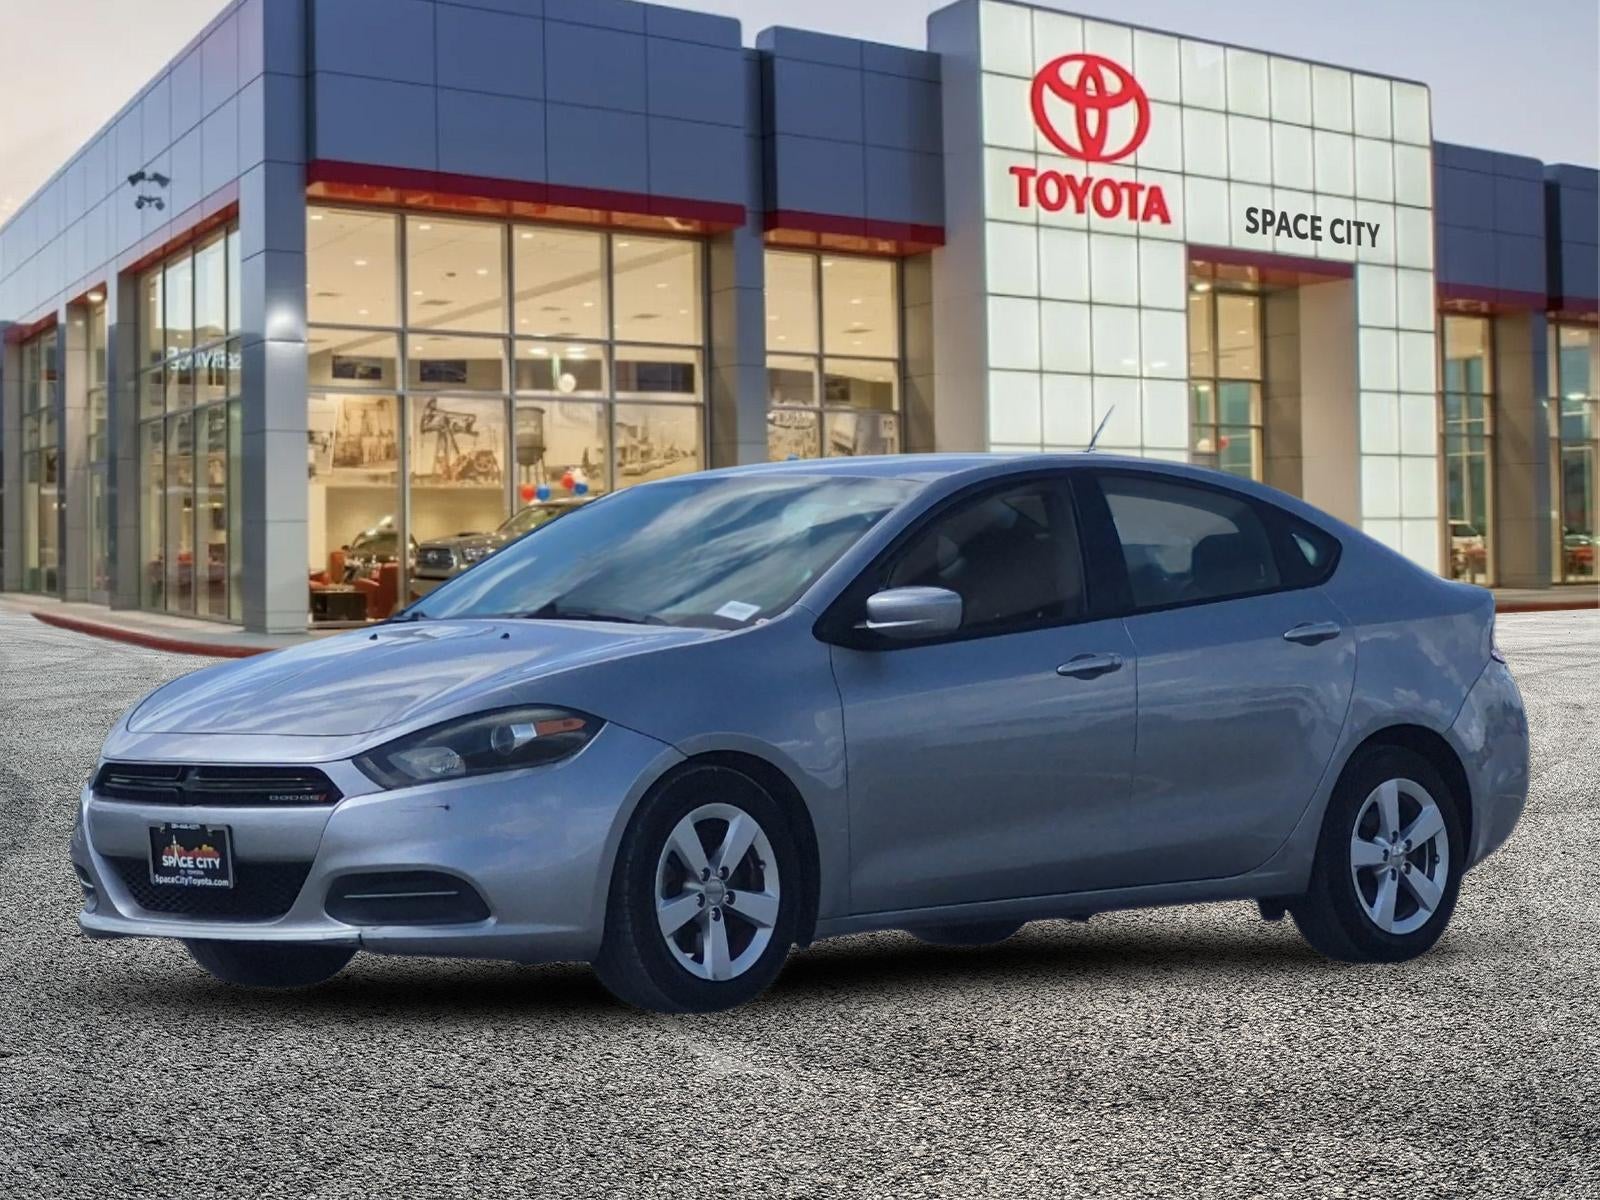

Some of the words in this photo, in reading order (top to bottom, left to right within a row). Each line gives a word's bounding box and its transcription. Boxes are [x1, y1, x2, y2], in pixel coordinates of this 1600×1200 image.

[1009, 166, 1171, 224] TOYOTA
[1245, 206, 1323, 242] SPACE
[1329, 217, 1381, 248] CITY
[162, 855, 195, 868] SPACE
[196, 857, 220, 869] CITY
[154, 873, 229, 887] SpaceCityToyota.com
